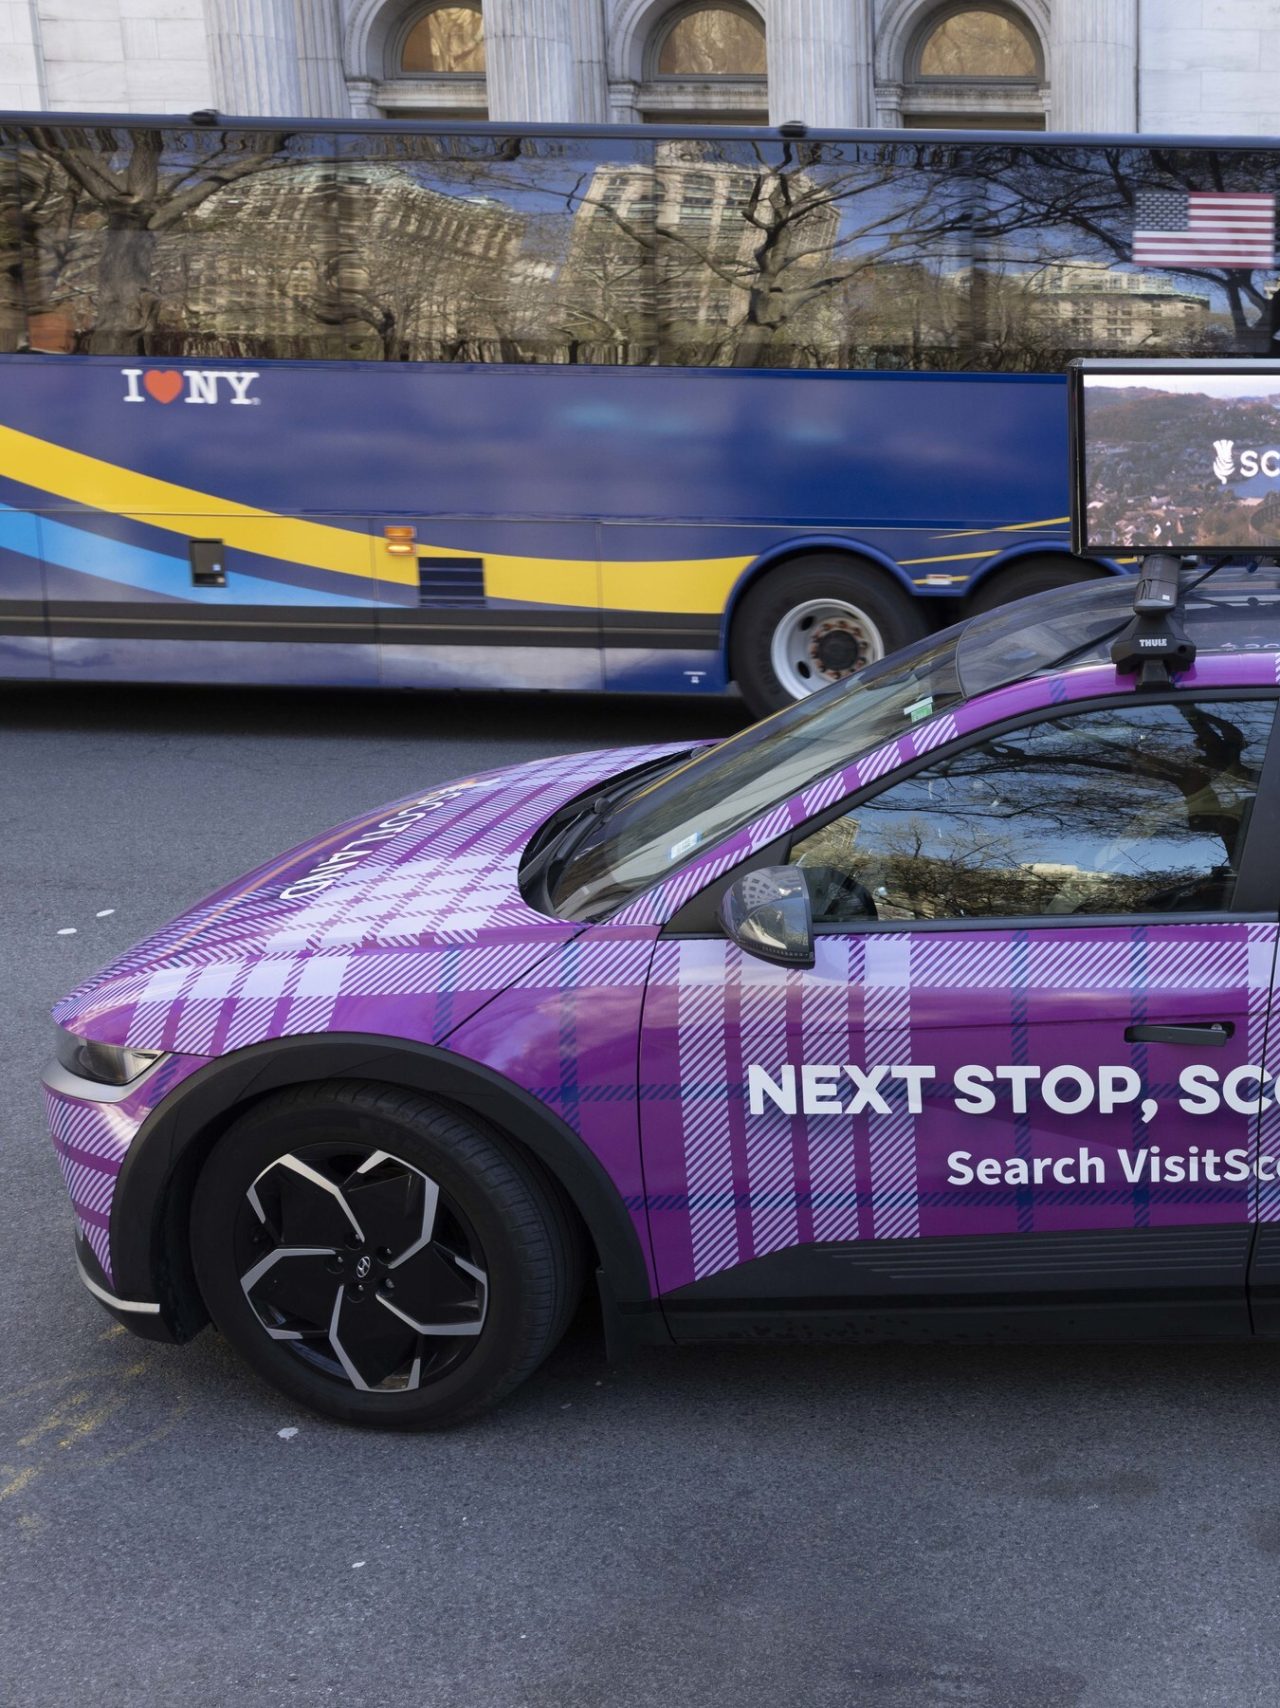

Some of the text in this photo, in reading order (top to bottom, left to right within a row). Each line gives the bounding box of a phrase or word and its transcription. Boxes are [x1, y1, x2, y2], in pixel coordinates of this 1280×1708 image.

[121, 368, 260, 405] I NY
[1139, 638, 1167, 647] THULE
[747, 1064, 936, 1115] NEXT
[953, 1064, 1158, 1124] STOP,
[947, 1146, 1105, 1186] Search
